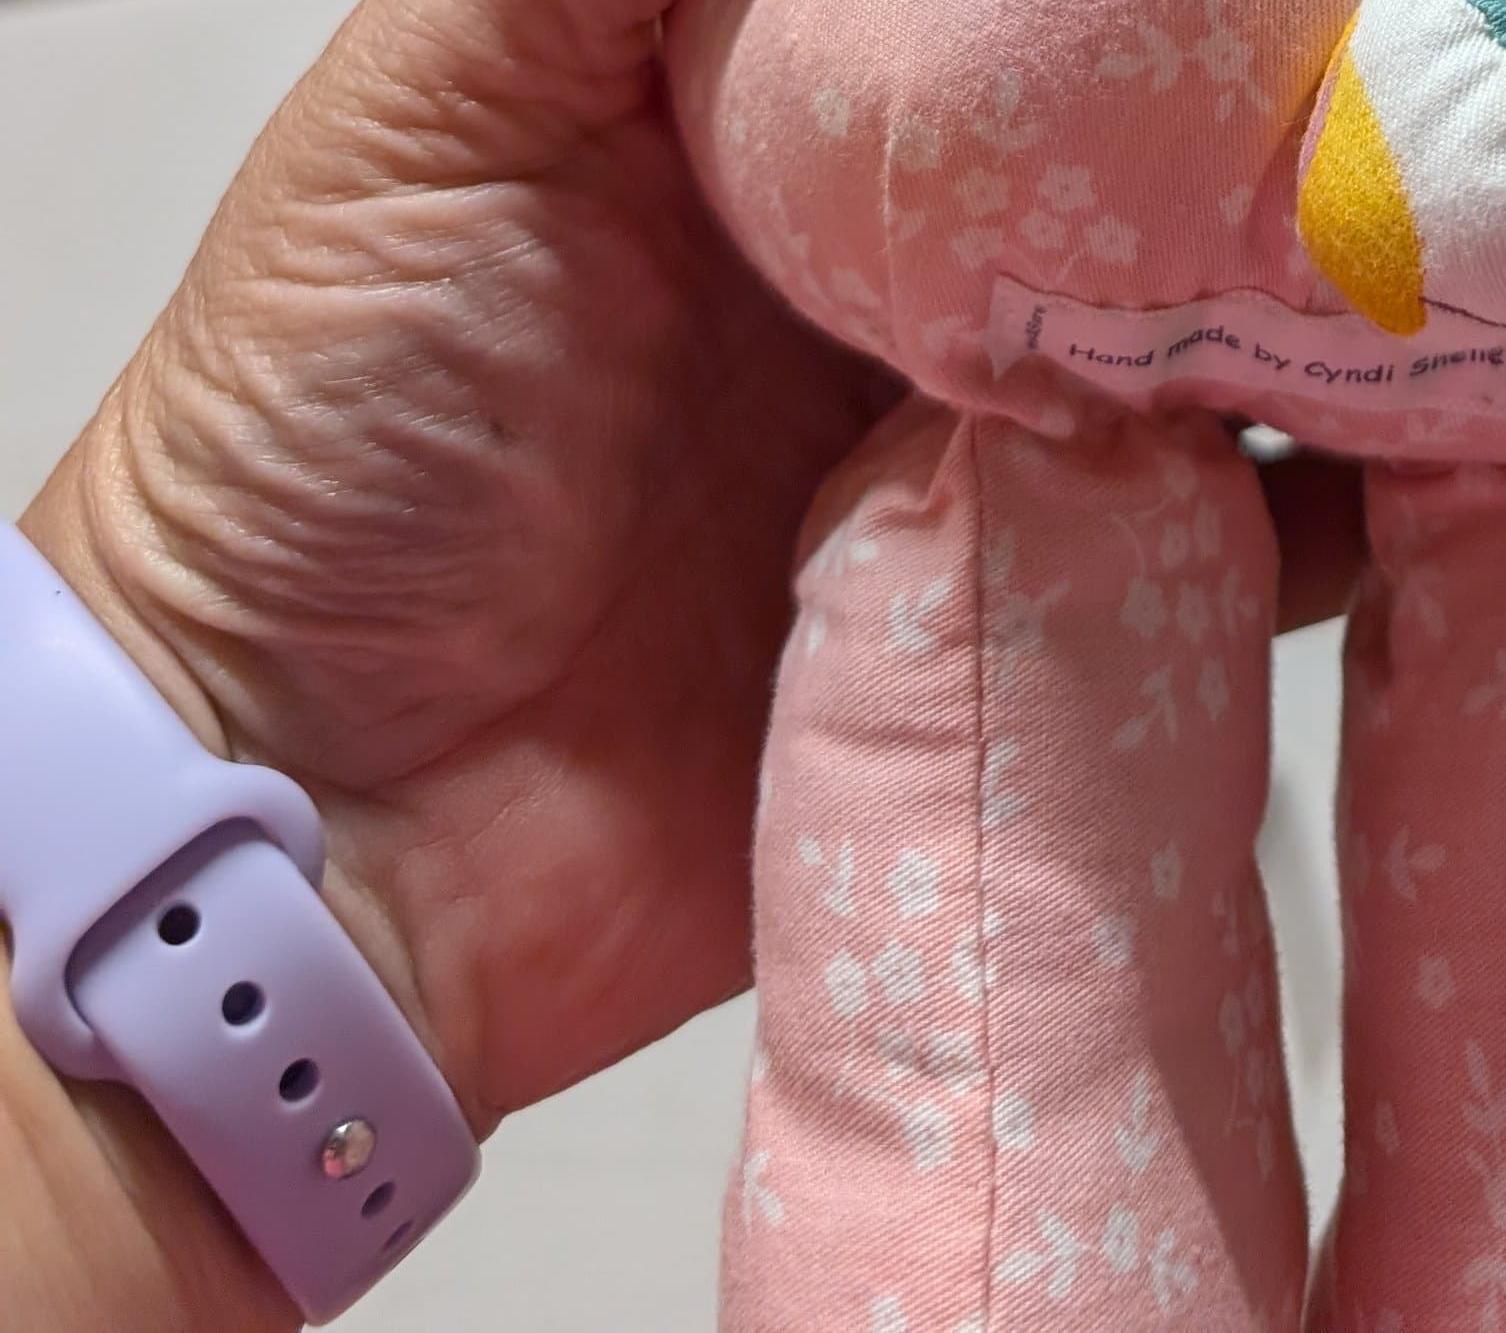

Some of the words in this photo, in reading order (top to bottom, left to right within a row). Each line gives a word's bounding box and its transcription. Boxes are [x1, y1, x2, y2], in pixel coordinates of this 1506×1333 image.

[1069, 342, 1154, 367] Hand
[1168, 325, 1241, 358] made
[1254, 343, 1291, 371] by
[1303, 361, 1394, 384] Cyndi
